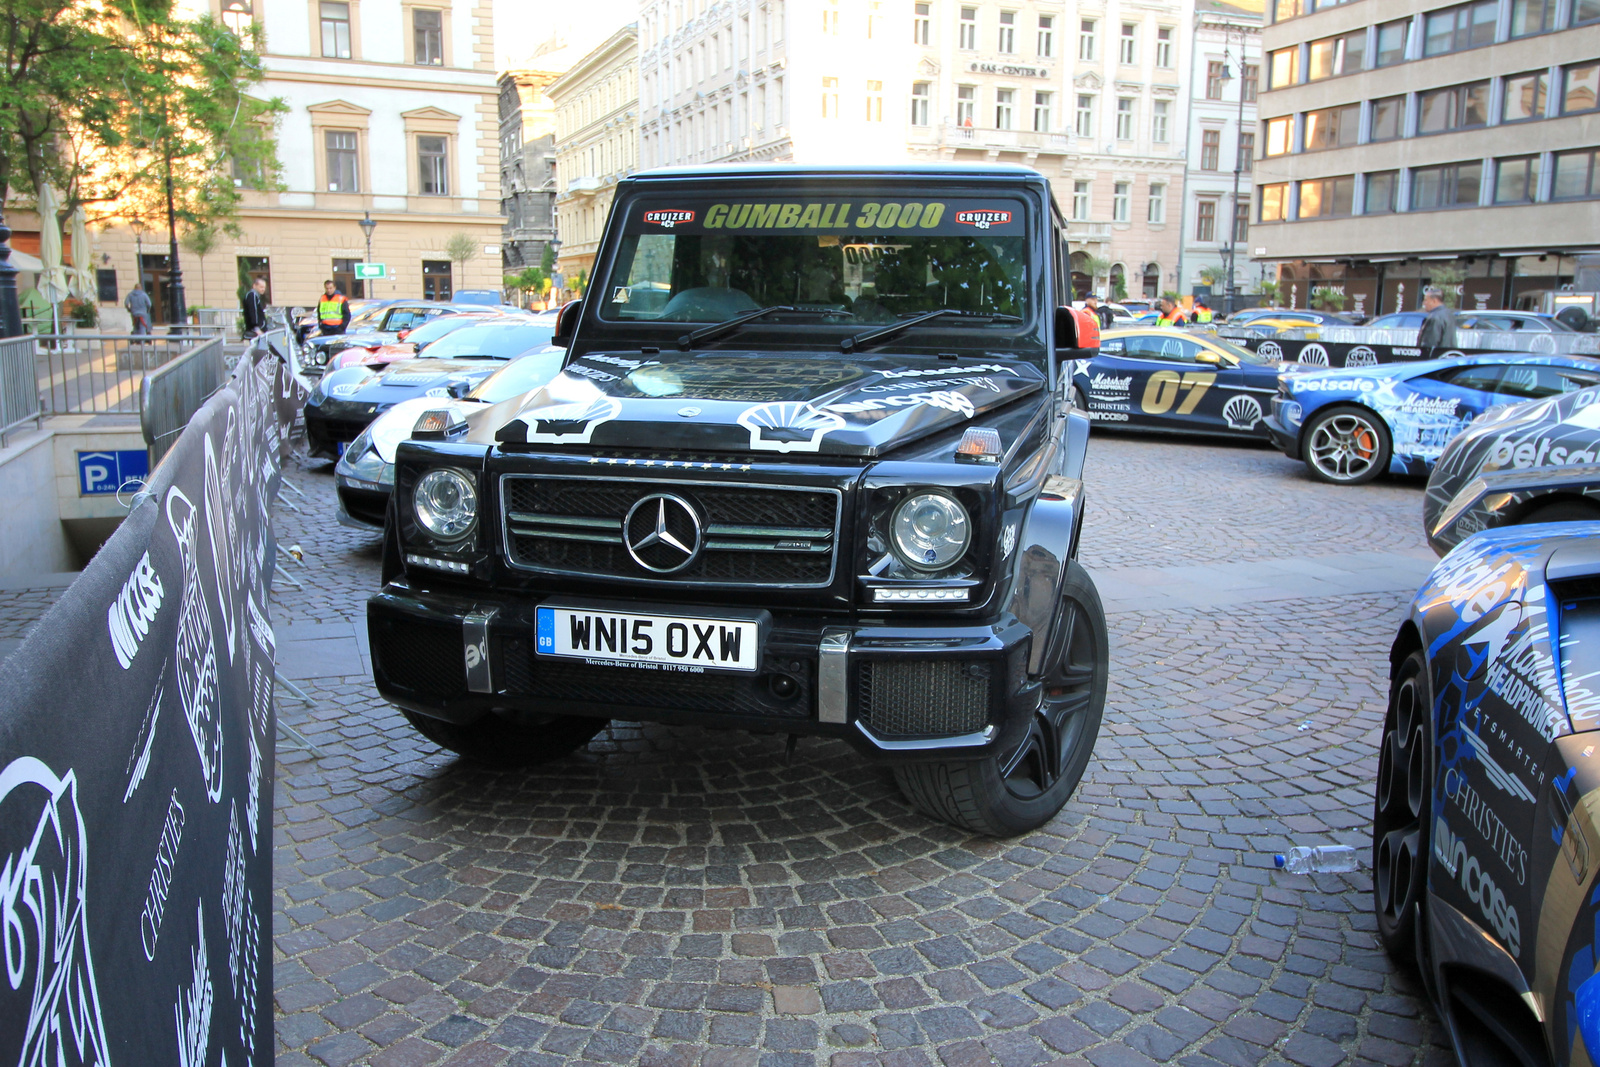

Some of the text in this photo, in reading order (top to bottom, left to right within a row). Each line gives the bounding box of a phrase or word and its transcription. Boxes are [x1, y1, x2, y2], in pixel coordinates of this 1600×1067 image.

[647, 212, 692, 221] CRUIZER
[702, 202, 946, 230] GUMBALL 3000
[958, 212, 1009, 222] CRUIZER
[1090, 372, 1133, 386] Marshall
[1141, 370, 1218, 415] 07
[1293, 377, 1375, 393] betsafe
[1402, 391, 1461, 409] Marshall
[1488, 435, 1600, 469] betsa
[84, 465, 109, 492] P
[539, 636, 553, 647] GB
[569, 614, 653, 655] WN15
[585, 657, 630, 667] Mercedes-Benz
[638, 662, 659, 670] Bristol
[662, 664, 677, 672] 0117
[677, 665, 688, 673] 950
[1484, 661, 1569, 744] HEADPHONES
[1465, 702, 1545, 785] JETSMARTER
[1444, 768, 1528, 886] CHRISTIE'S
[140, 786, 186, 962] CHRISTIE'S
[1447, 828, 1521, 959] incase
